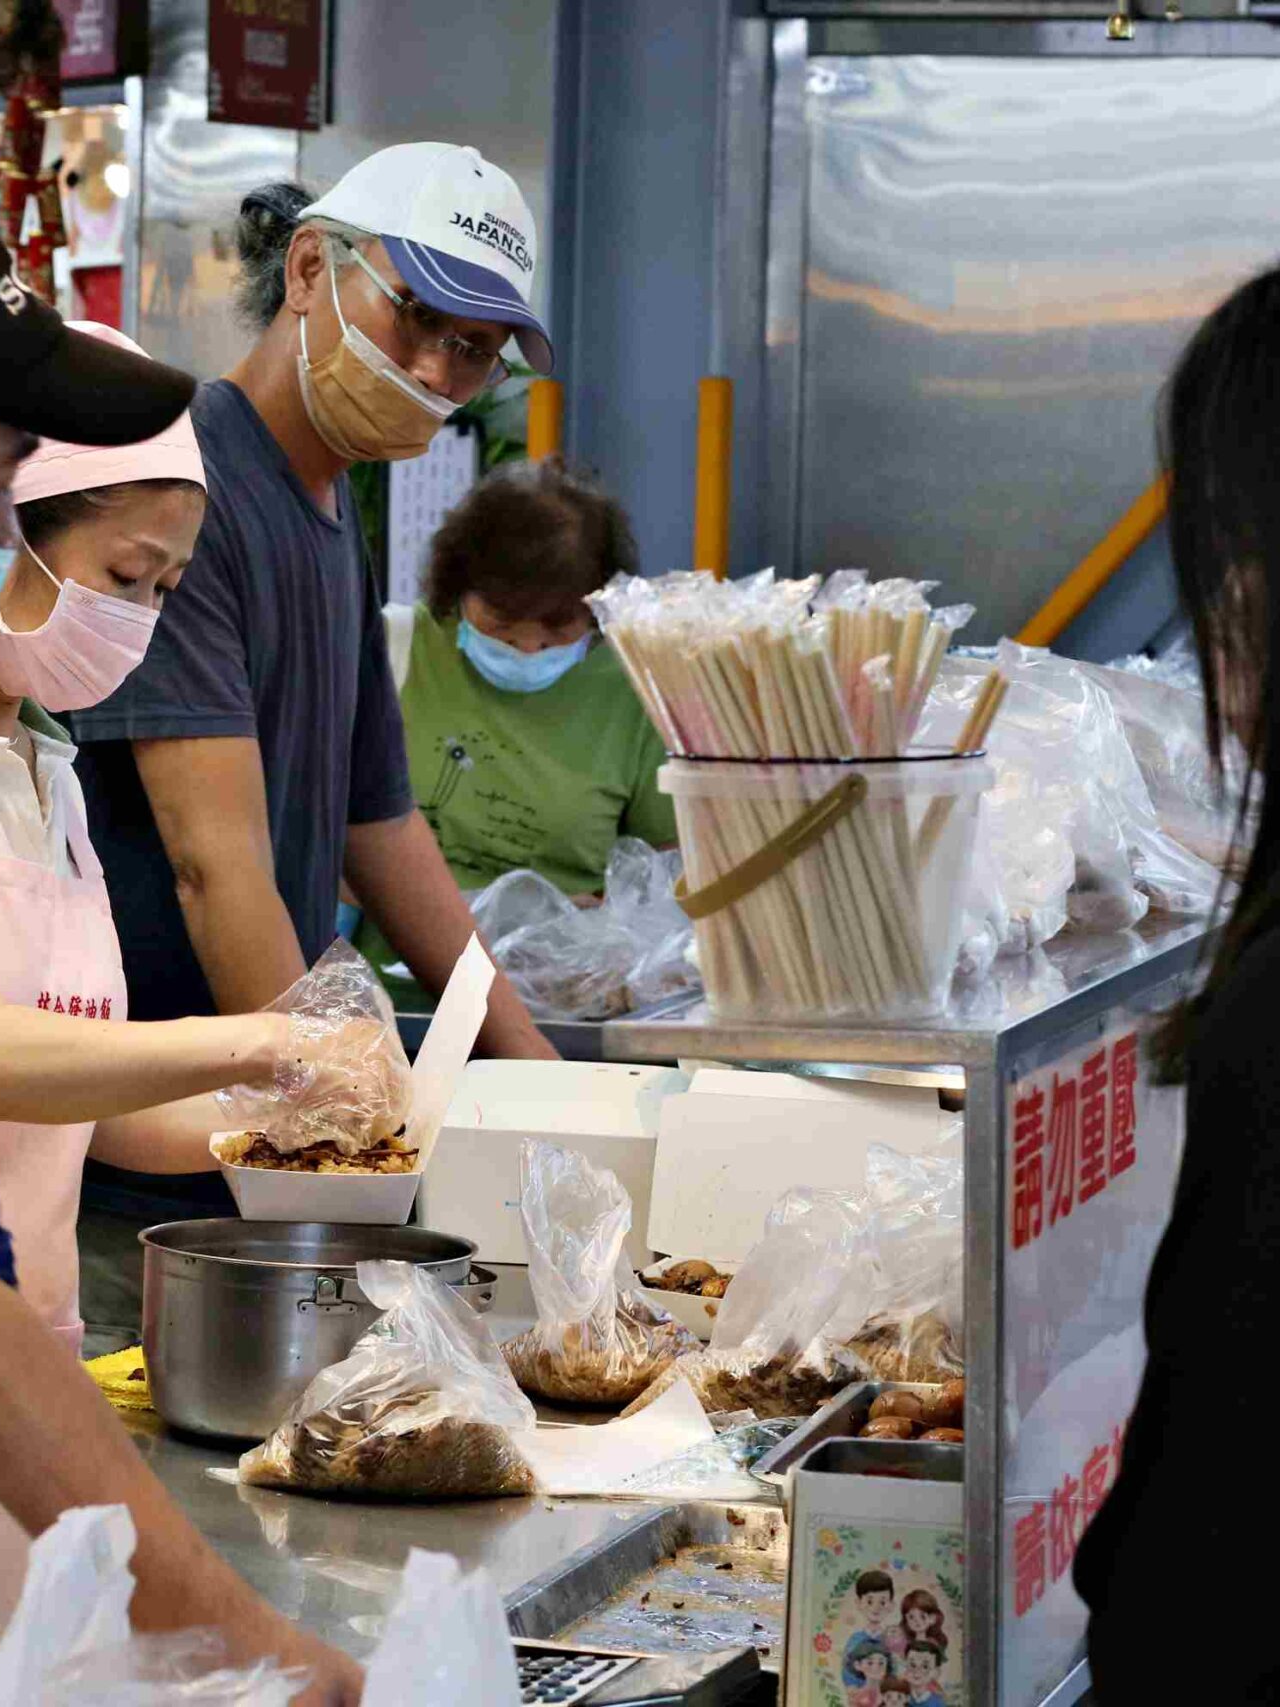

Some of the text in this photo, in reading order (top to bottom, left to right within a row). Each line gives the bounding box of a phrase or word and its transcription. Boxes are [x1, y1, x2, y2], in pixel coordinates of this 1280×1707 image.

[449, 212, 514, 252] JAPAN
[1012, 1031, 1138, 1251] 請勿重壓
